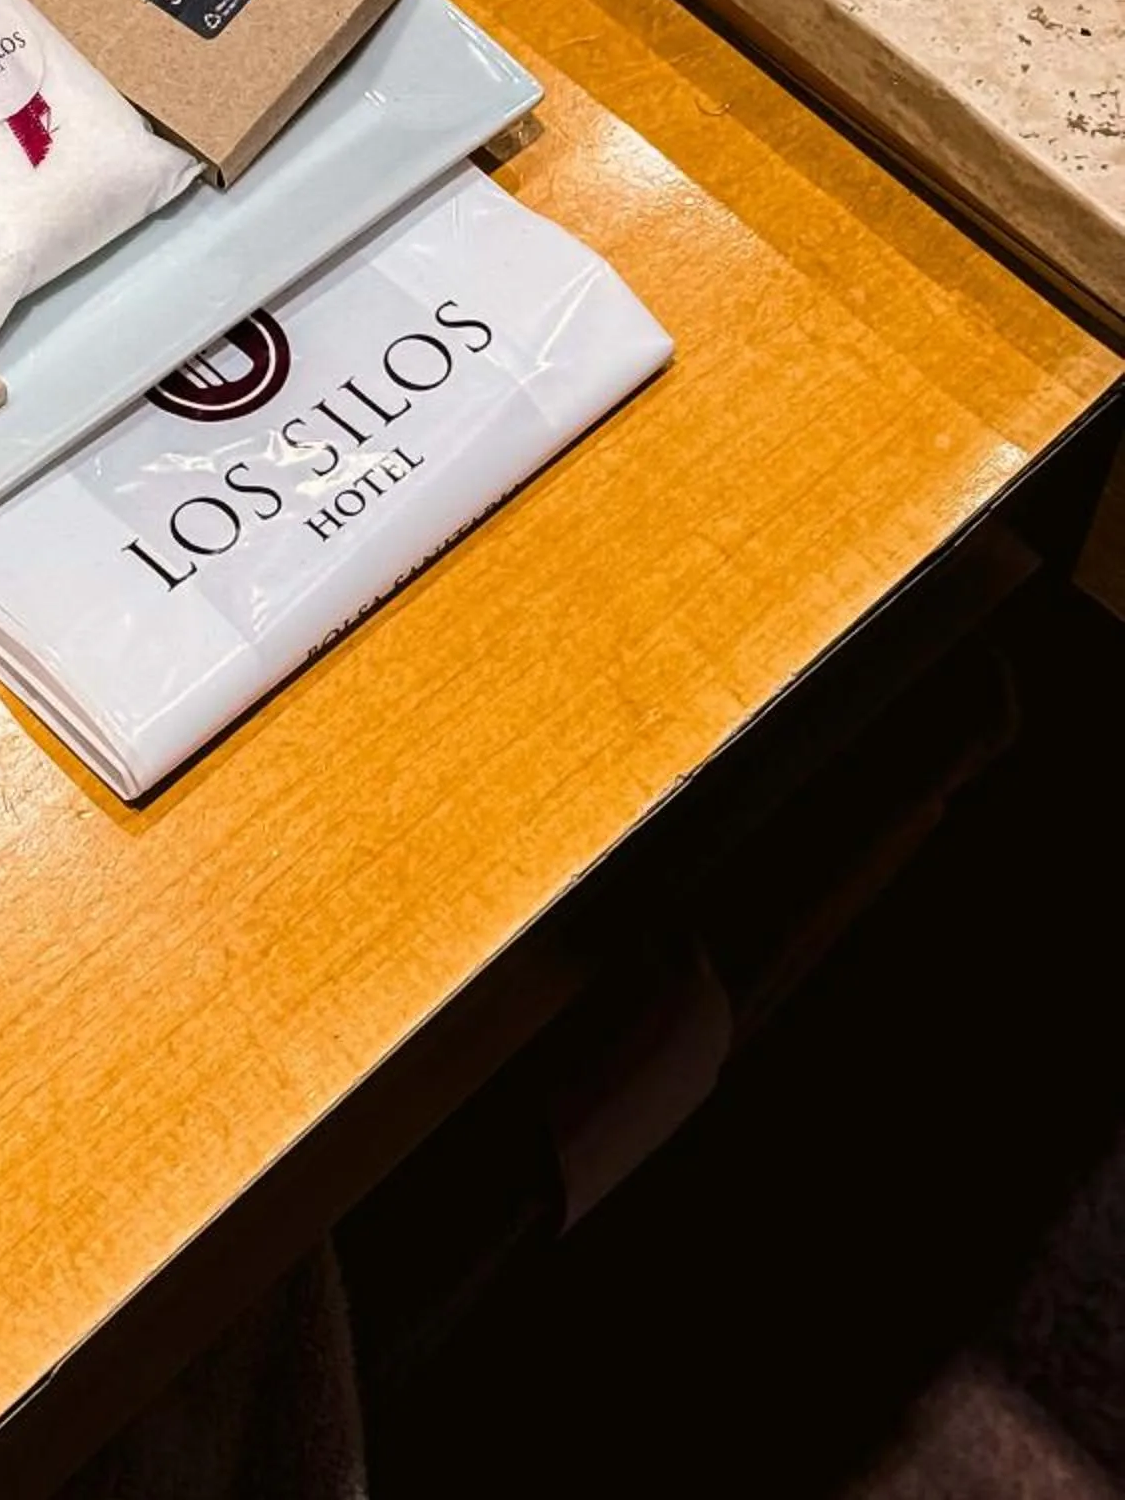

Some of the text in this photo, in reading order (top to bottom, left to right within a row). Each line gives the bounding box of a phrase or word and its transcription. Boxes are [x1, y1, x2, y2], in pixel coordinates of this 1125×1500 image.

[121, 461, 284, 592] LOS
[281, 299, 493, 478] SILOS
[302, 445, 426, 542] HOTEL
